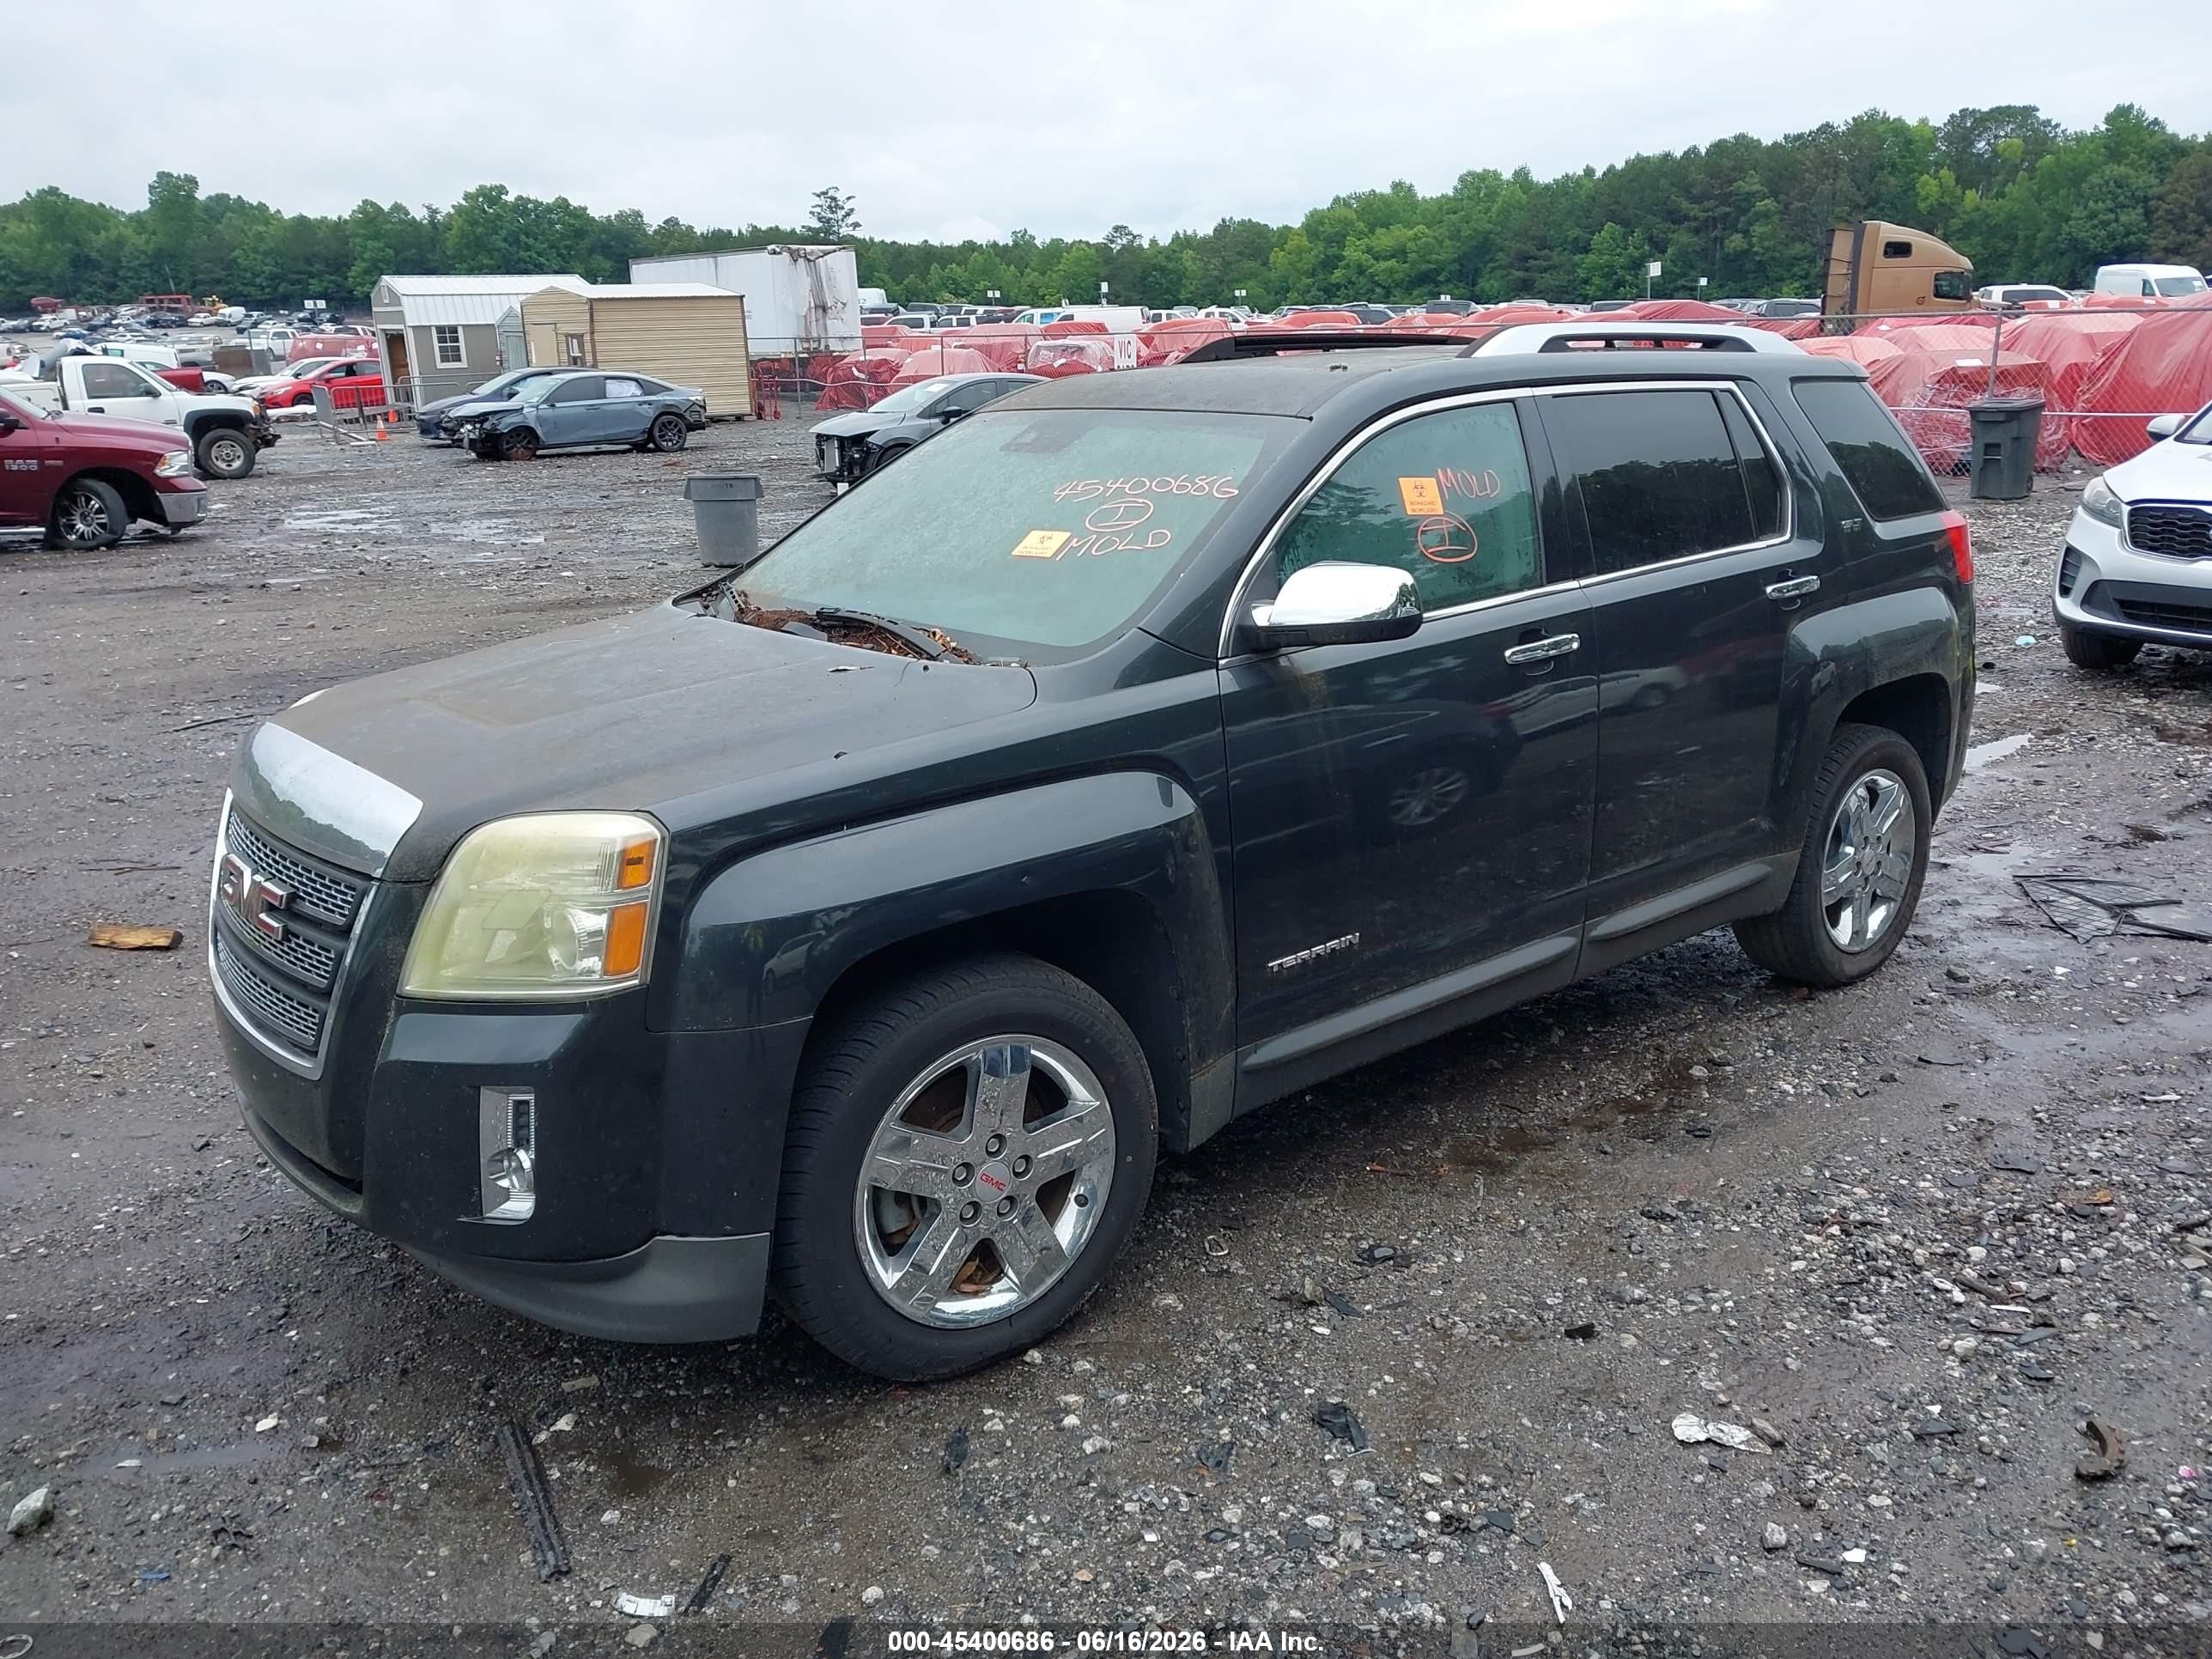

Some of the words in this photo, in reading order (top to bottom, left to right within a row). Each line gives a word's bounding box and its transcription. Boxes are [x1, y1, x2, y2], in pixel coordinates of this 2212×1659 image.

[1118, 339, 1132, 359] VIC
[1437, 468, 1500, 500] MOLD
[1056, 529, 1171, 561] MOLD
[221, 854, 292, 941] GMC
[1267, 933, 1359, 972] TERRAIN
[980, 1173, 1006, 1192] GMC
